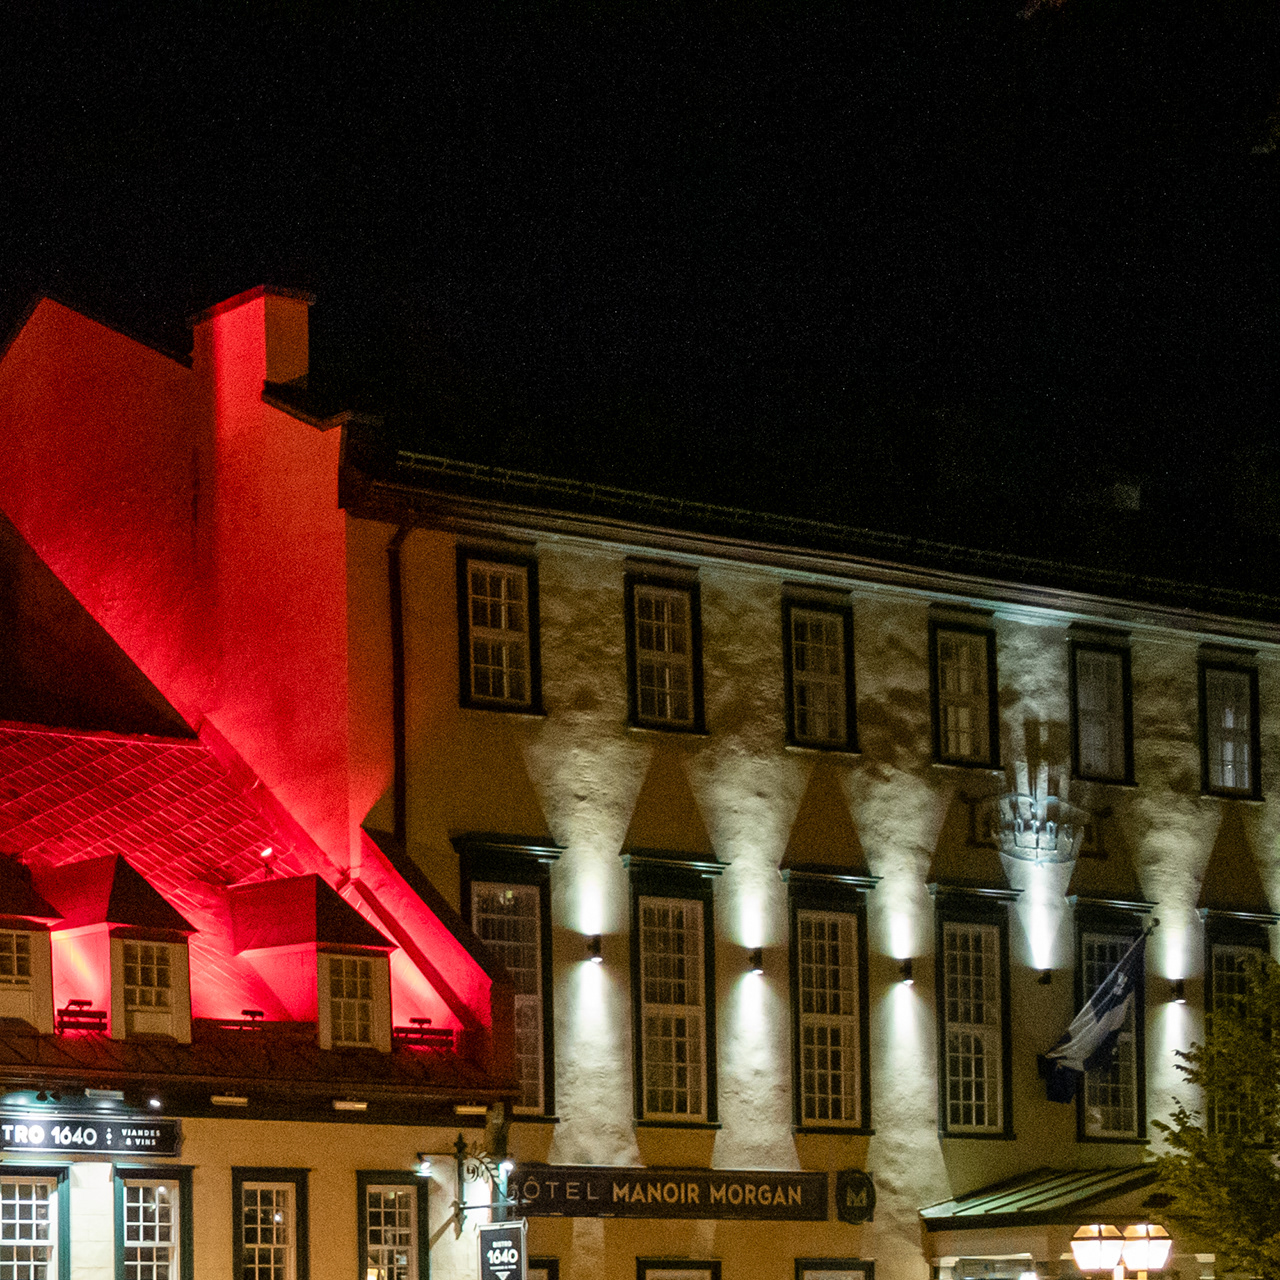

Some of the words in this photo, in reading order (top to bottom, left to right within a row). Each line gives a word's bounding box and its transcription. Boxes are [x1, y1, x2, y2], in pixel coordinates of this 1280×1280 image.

[50, 1125, 99, 1146] 1640
[121, 1128, 161, 1137] VIANDES
[135, 1138, 157, 1146] VINS
[508, 1176, 600, 1201] ÔTEL
[612, 1182, 700, 1204] MANOIR
[709, 1184, 803, 1206] MORGAN
[486, 1249, 519, 1265] 1640
